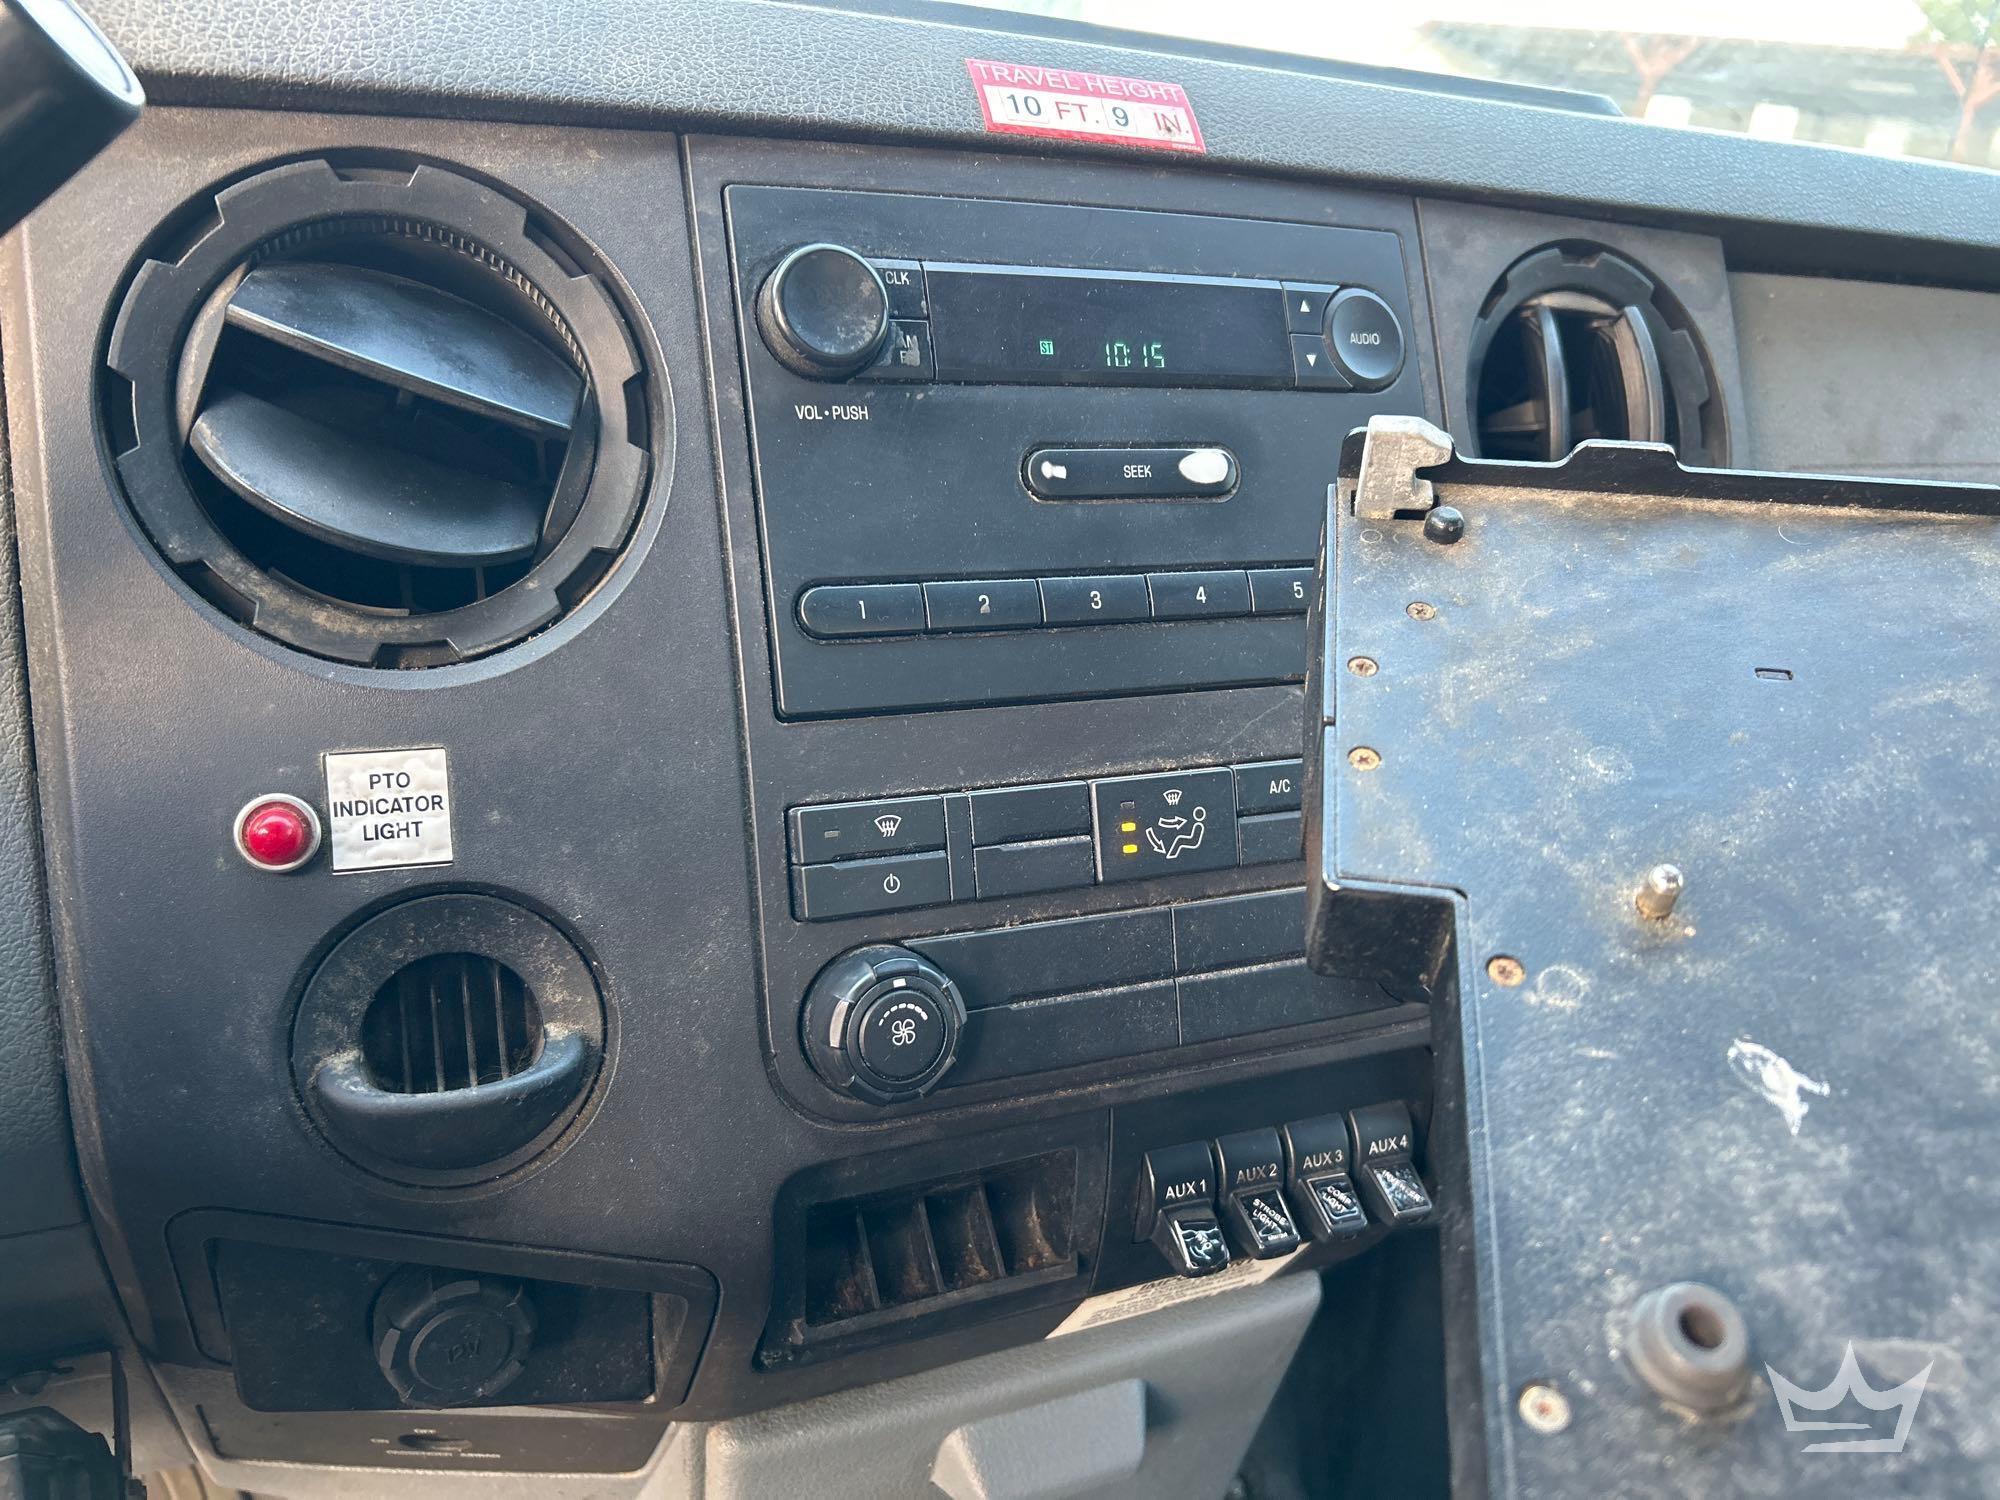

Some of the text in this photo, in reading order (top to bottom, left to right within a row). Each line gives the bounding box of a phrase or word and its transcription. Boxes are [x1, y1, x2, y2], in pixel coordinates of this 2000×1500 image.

[976, 63, 1181, 102] TRAVEL HEIGHT
[1006, 93, 1042, 117] 10
[1054, 101, 1100, 124] FT.
[1111, 106, 1129, 127] 9
[885, 271, 911, 285] CLK
[1040, 340, 1054, 355] ST
[1349, 332, 1380, 346] AUDIO
[1105, 343, 1165, 368] 10:15
[794, 404, 869, 420] VOL PUSH
[1123, 464, 1152, 479] SEEK
[857, 581, 1304, 620] 1 2 3 4 5
[369, 772, 411, 790] PTO
[1269, 778, 1291, 794] A/C
[332, 795, 444, 818] INDICATOR
[363, 821, 424, 842] LIGHT
[1368, 1135, 1409, 1156] AUX 4
[1302, 1149, 1344, 1170] AUX 3
[1236, 1163, 1278, 1184] AUX 2
[1165, 1179, 1207, 1200] AUX 1
[1252, 1198, 1288, 1226] STROBE
[1252, 1208, 1277, 1230] LIGHT
